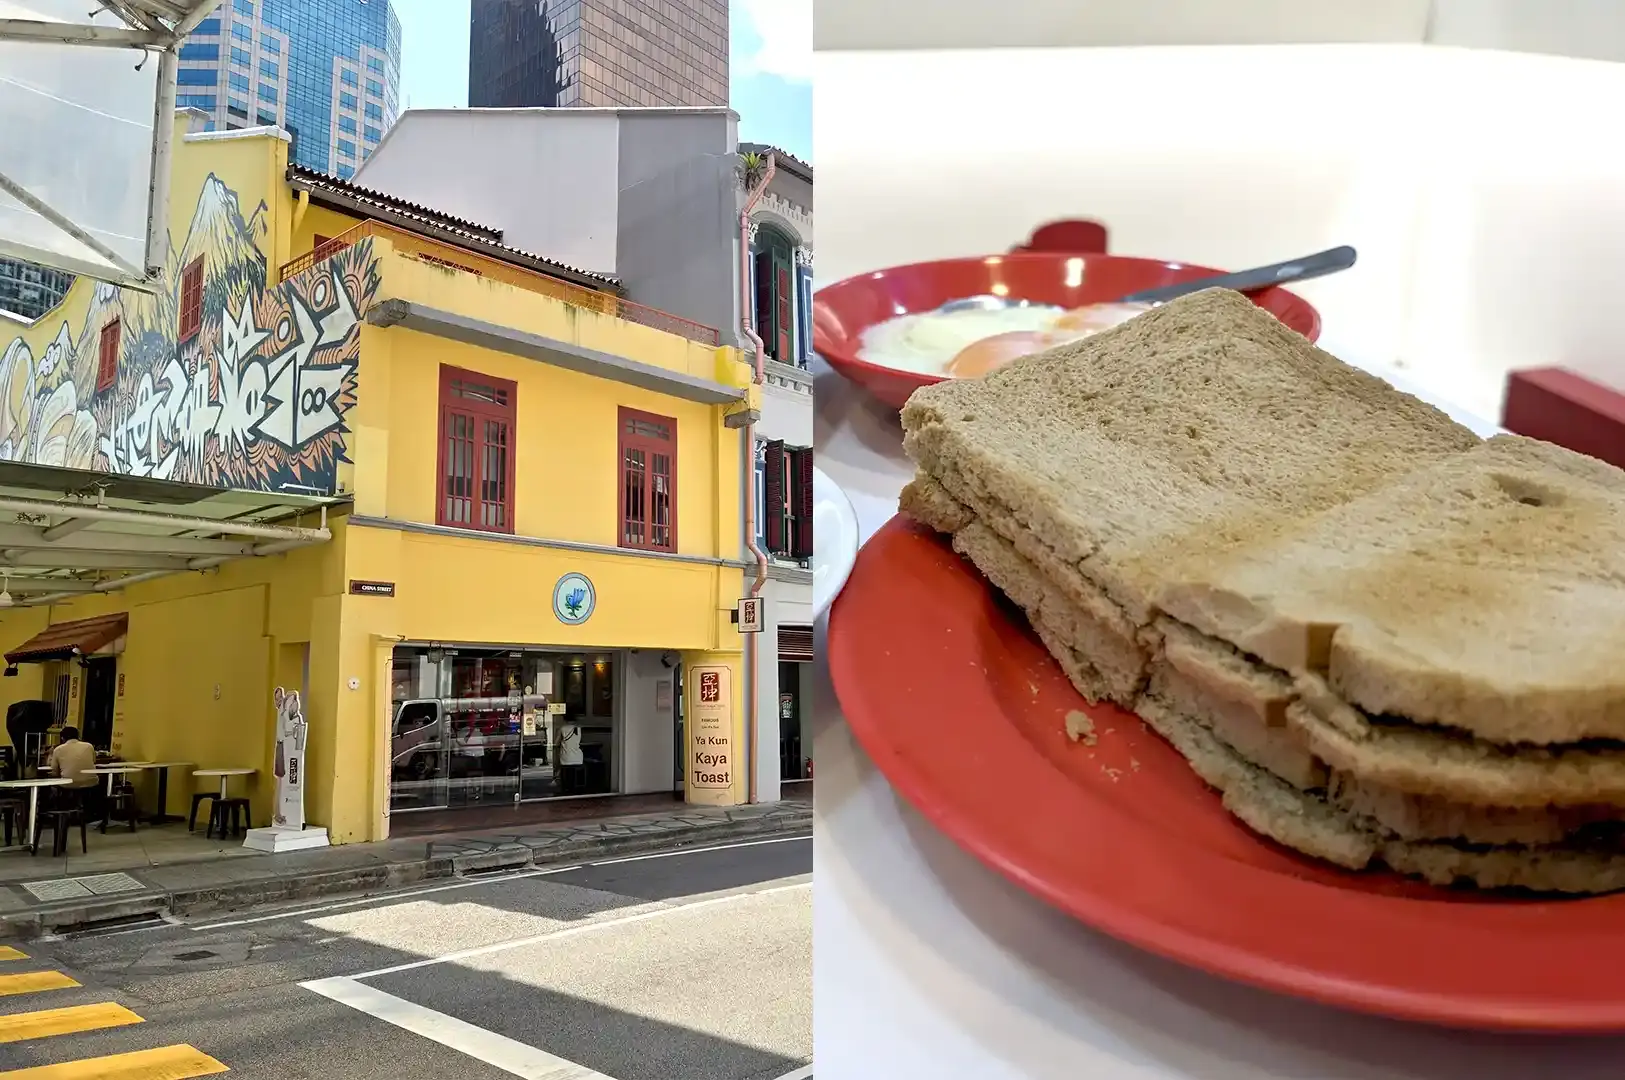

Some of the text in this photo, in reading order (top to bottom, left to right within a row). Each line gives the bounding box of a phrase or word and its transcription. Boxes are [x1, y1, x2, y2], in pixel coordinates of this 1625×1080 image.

[695, 736, 728, 745] Ya Kun
[695, 752, 727, 767] Kaya
[694, 771, 730, 783] Toast
